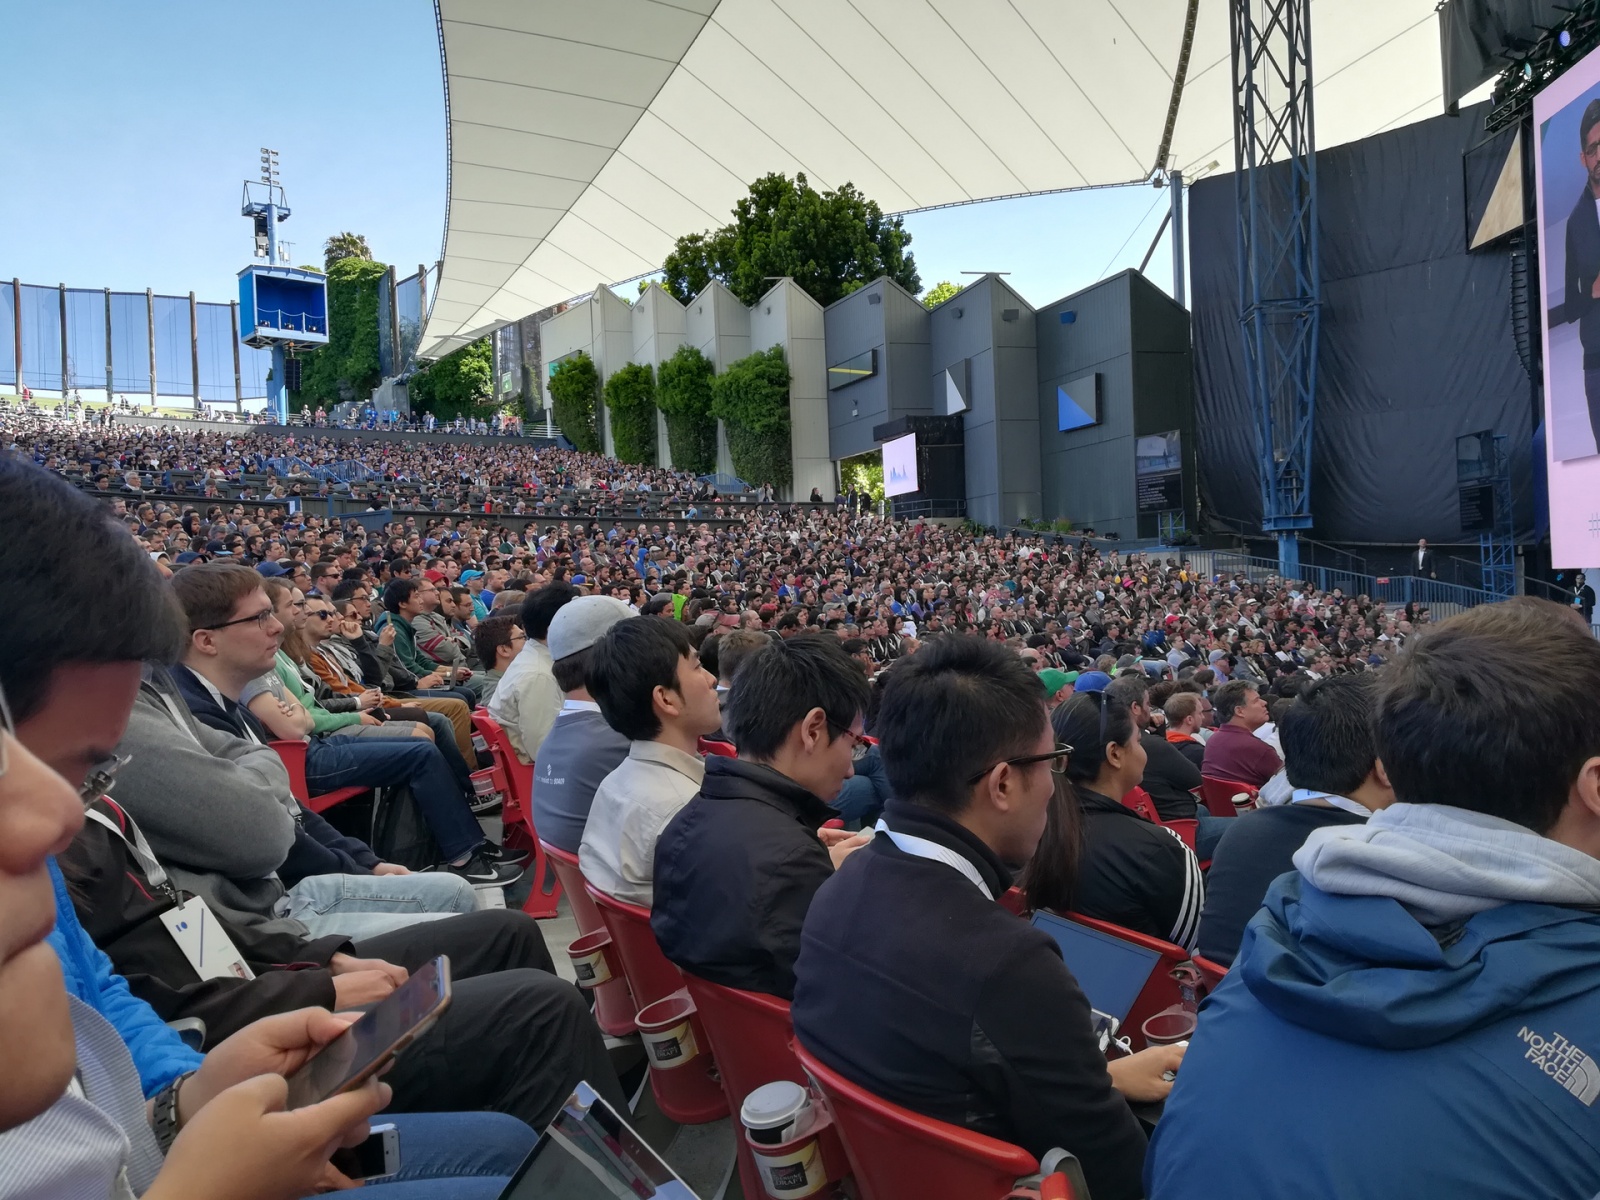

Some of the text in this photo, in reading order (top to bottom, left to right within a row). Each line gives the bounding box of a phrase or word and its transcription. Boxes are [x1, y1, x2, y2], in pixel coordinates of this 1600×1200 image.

[1516, 1025, 1578, 1075] NORTH
[1524, 1046, 1570, 1086] FACE
[1551, 1031, 1587, 1065] THE
